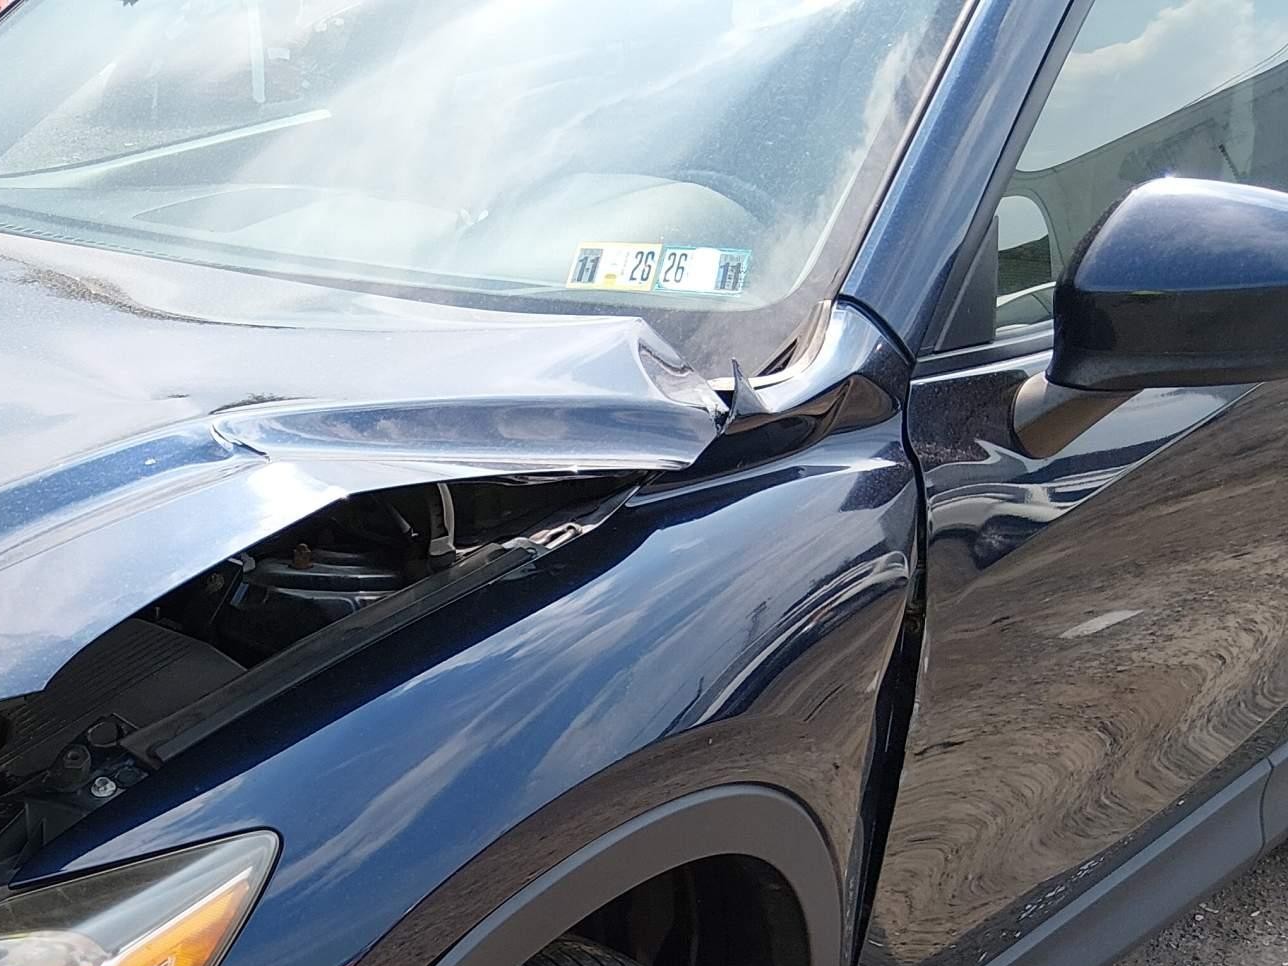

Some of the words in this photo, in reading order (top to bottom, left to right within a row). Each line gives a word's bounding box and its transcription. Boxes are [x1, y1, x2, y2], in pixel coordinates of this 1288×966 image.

[576, 256, 600, 283] 11
[631, 251, 656, 282] 26
[662, 252, 689, 283] 26
[719, 261, 743, 291] 11
